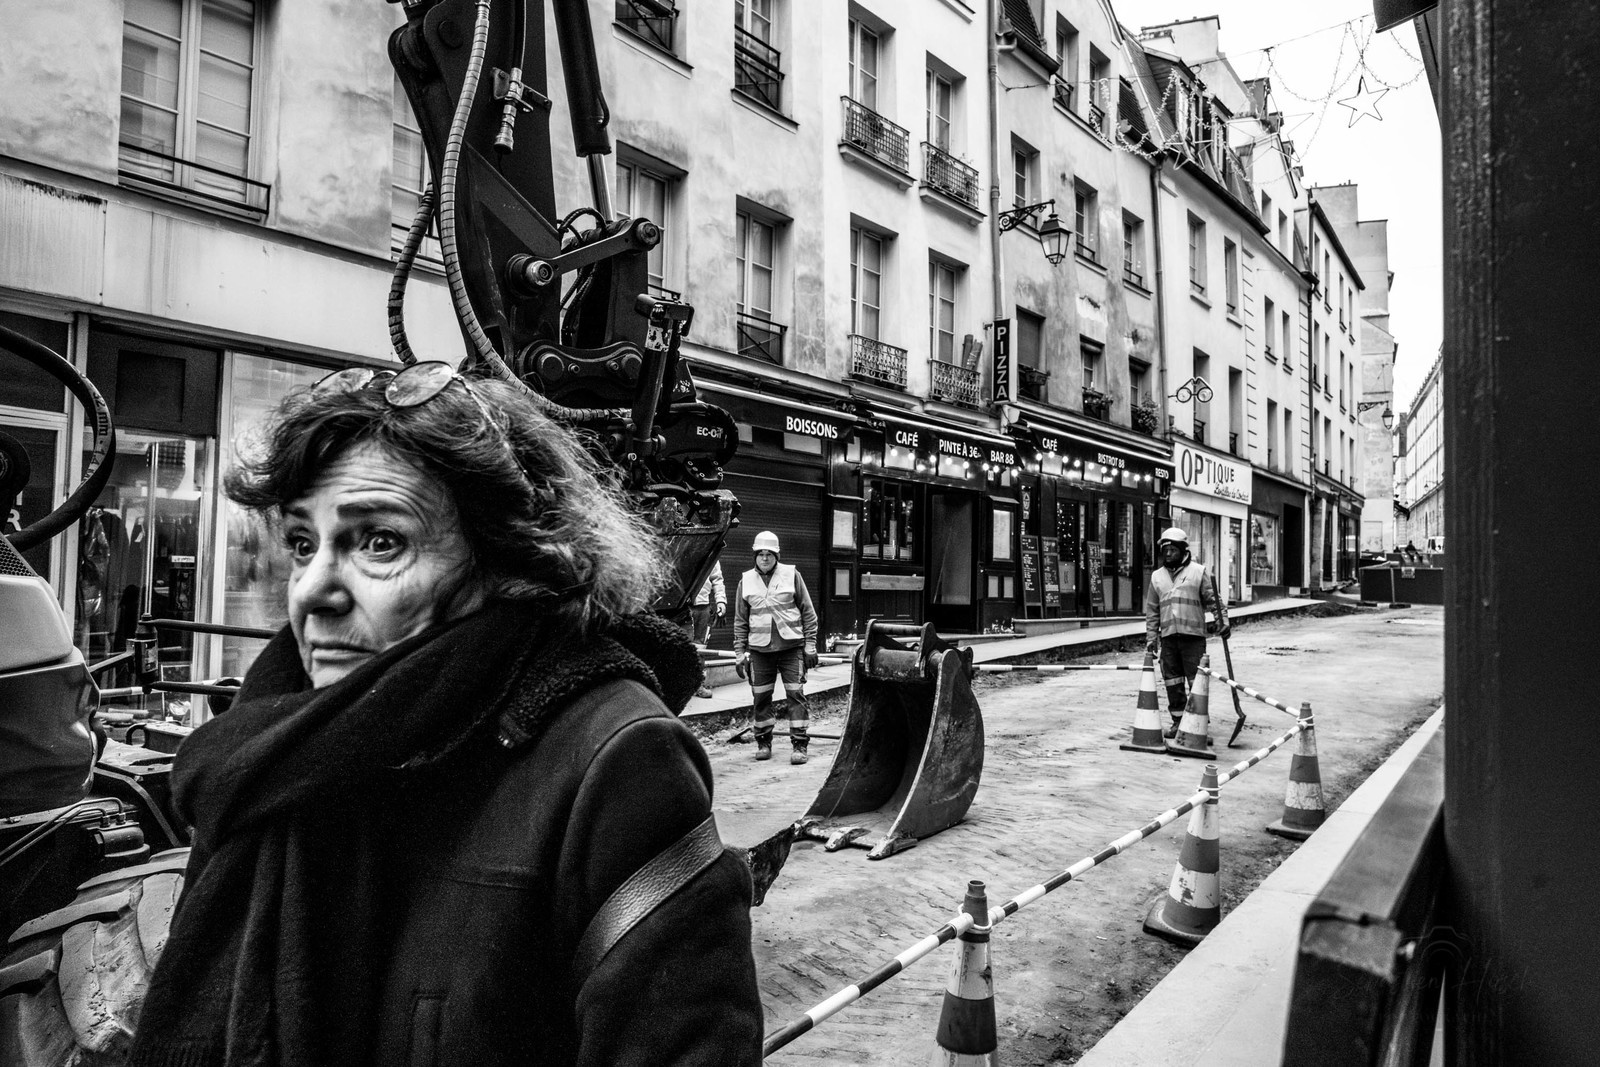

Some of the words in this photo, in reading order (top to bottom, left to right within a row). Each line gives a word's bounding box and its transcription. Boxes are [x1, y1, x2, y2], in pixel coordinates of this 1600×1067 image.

[996, 326, 1008, 399] PIZZA
[786, 415, 838, 439] BOISSONS
[895, 430, 919, 447] CAFÉ
[1042, 437, 1058, 452] CAFÉ
[939, 438, 961, 455] PINTE
[962, 442, 968, 457] À
[990, 450, 1005, 464] BAR
[1005, 453, 1015, 465] 88
[1097, 452, 1118, 468] BISTROT
[1118, 457, 1125, 469] 88
[1155, 467, 1169, 480] RESTO
[1181, 448, 1235, 487] OPTIQUE
